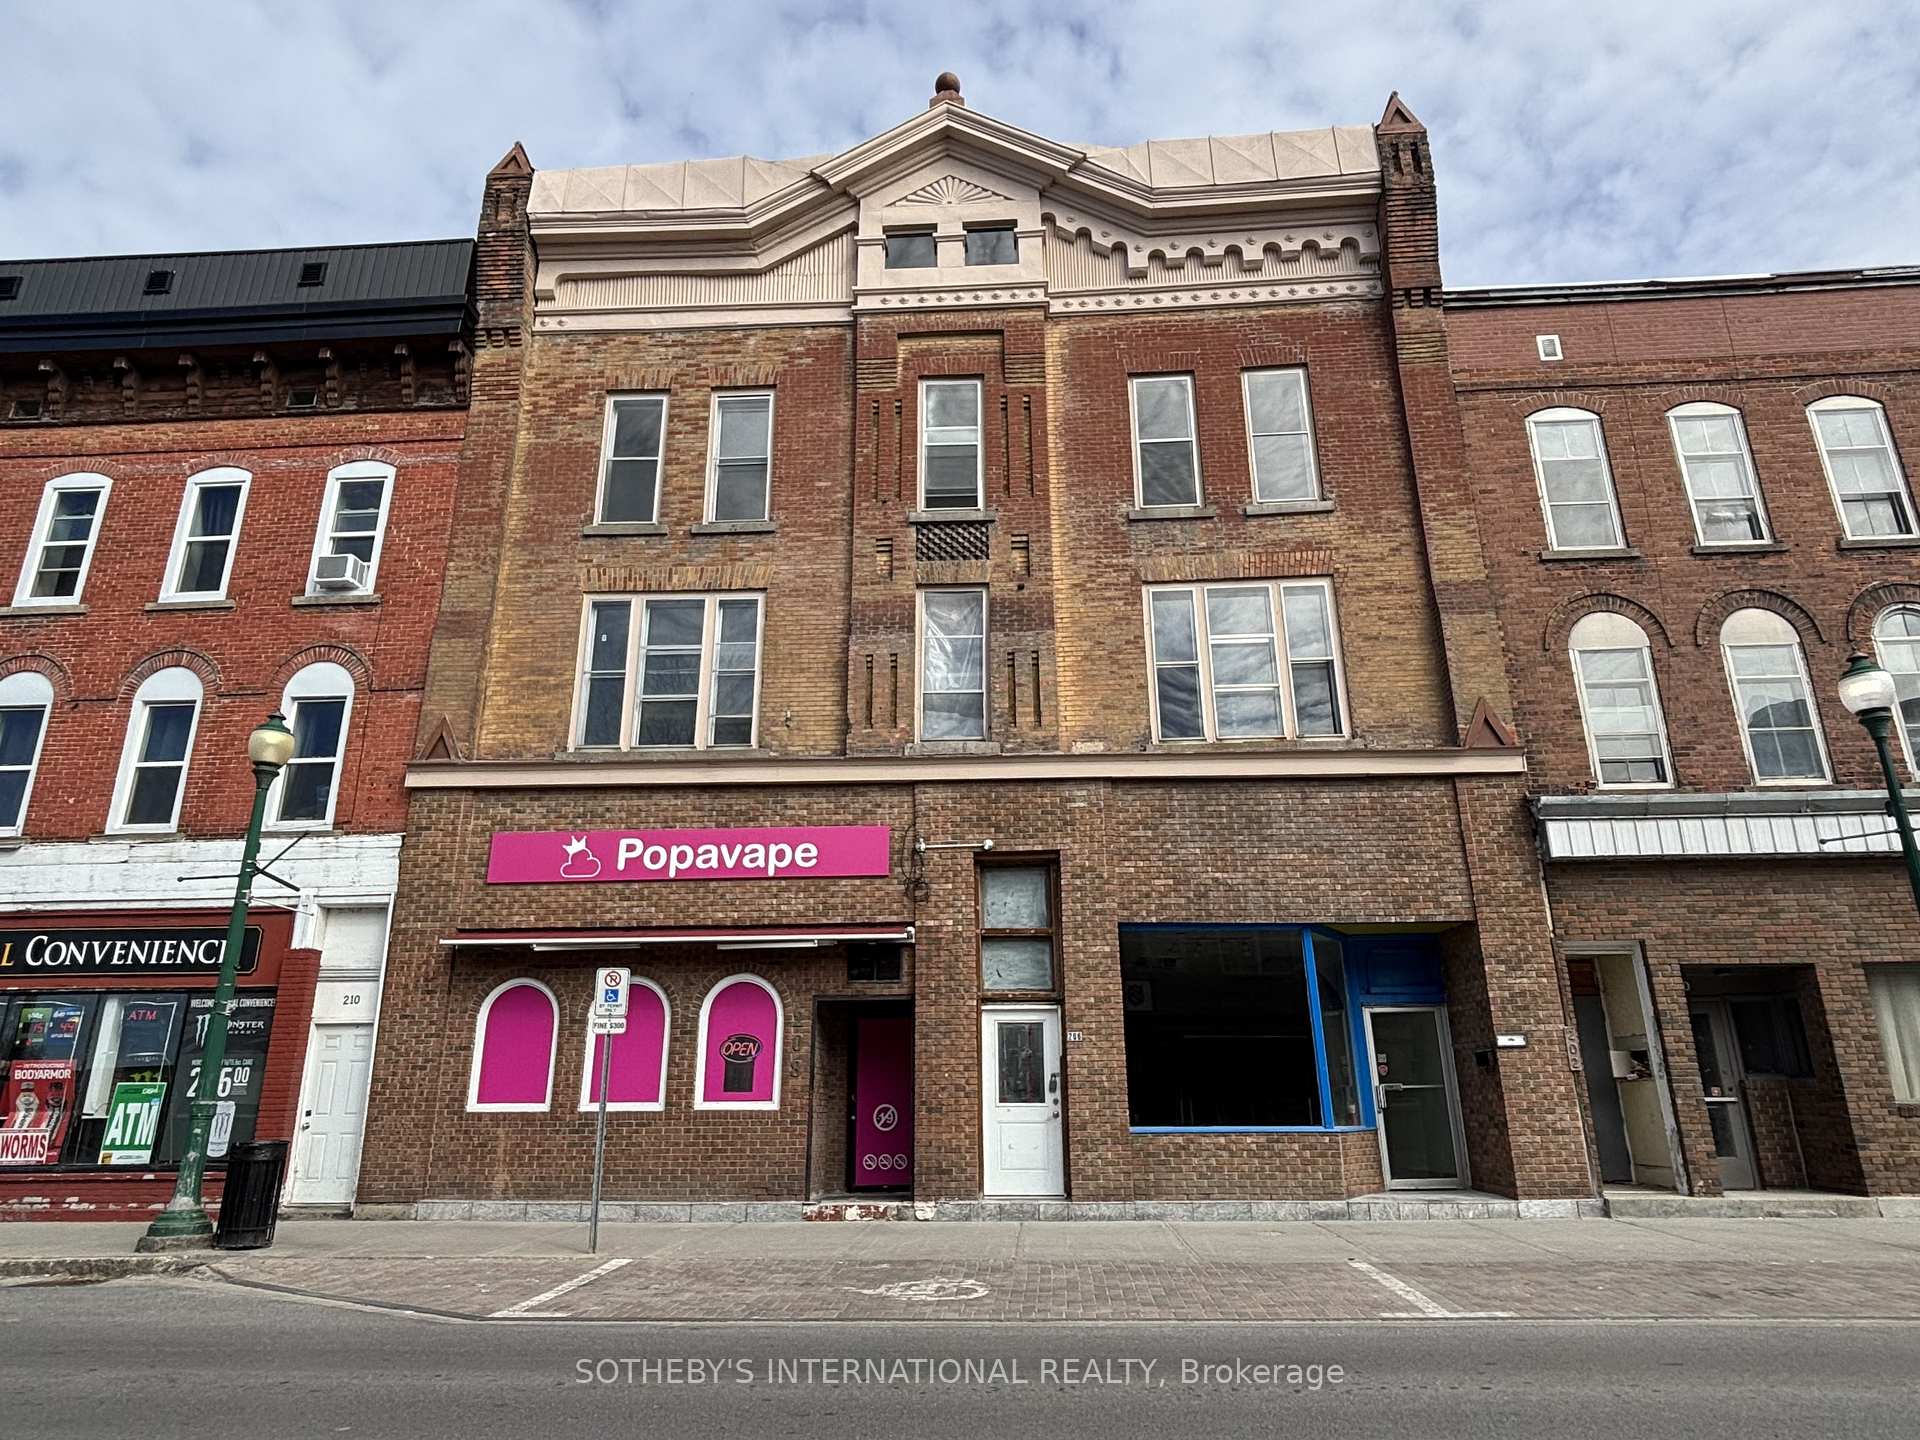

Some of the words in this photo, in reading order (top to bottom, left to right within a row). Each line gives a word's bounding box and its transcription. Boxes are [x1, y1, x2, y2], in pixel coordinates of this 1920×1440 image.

[616, 838, 818, 878] Popavape
[343, 995, 361, 1005] 210
[128, 1009, 157, 1020] ATM
[723, 1042, 758, 1056] OPEN
[14, 1069, 71, 1080] BODYARMOR
[104, 1102, 159, 1146] ATM
[0, 1134, 47, 1159] WORMS
